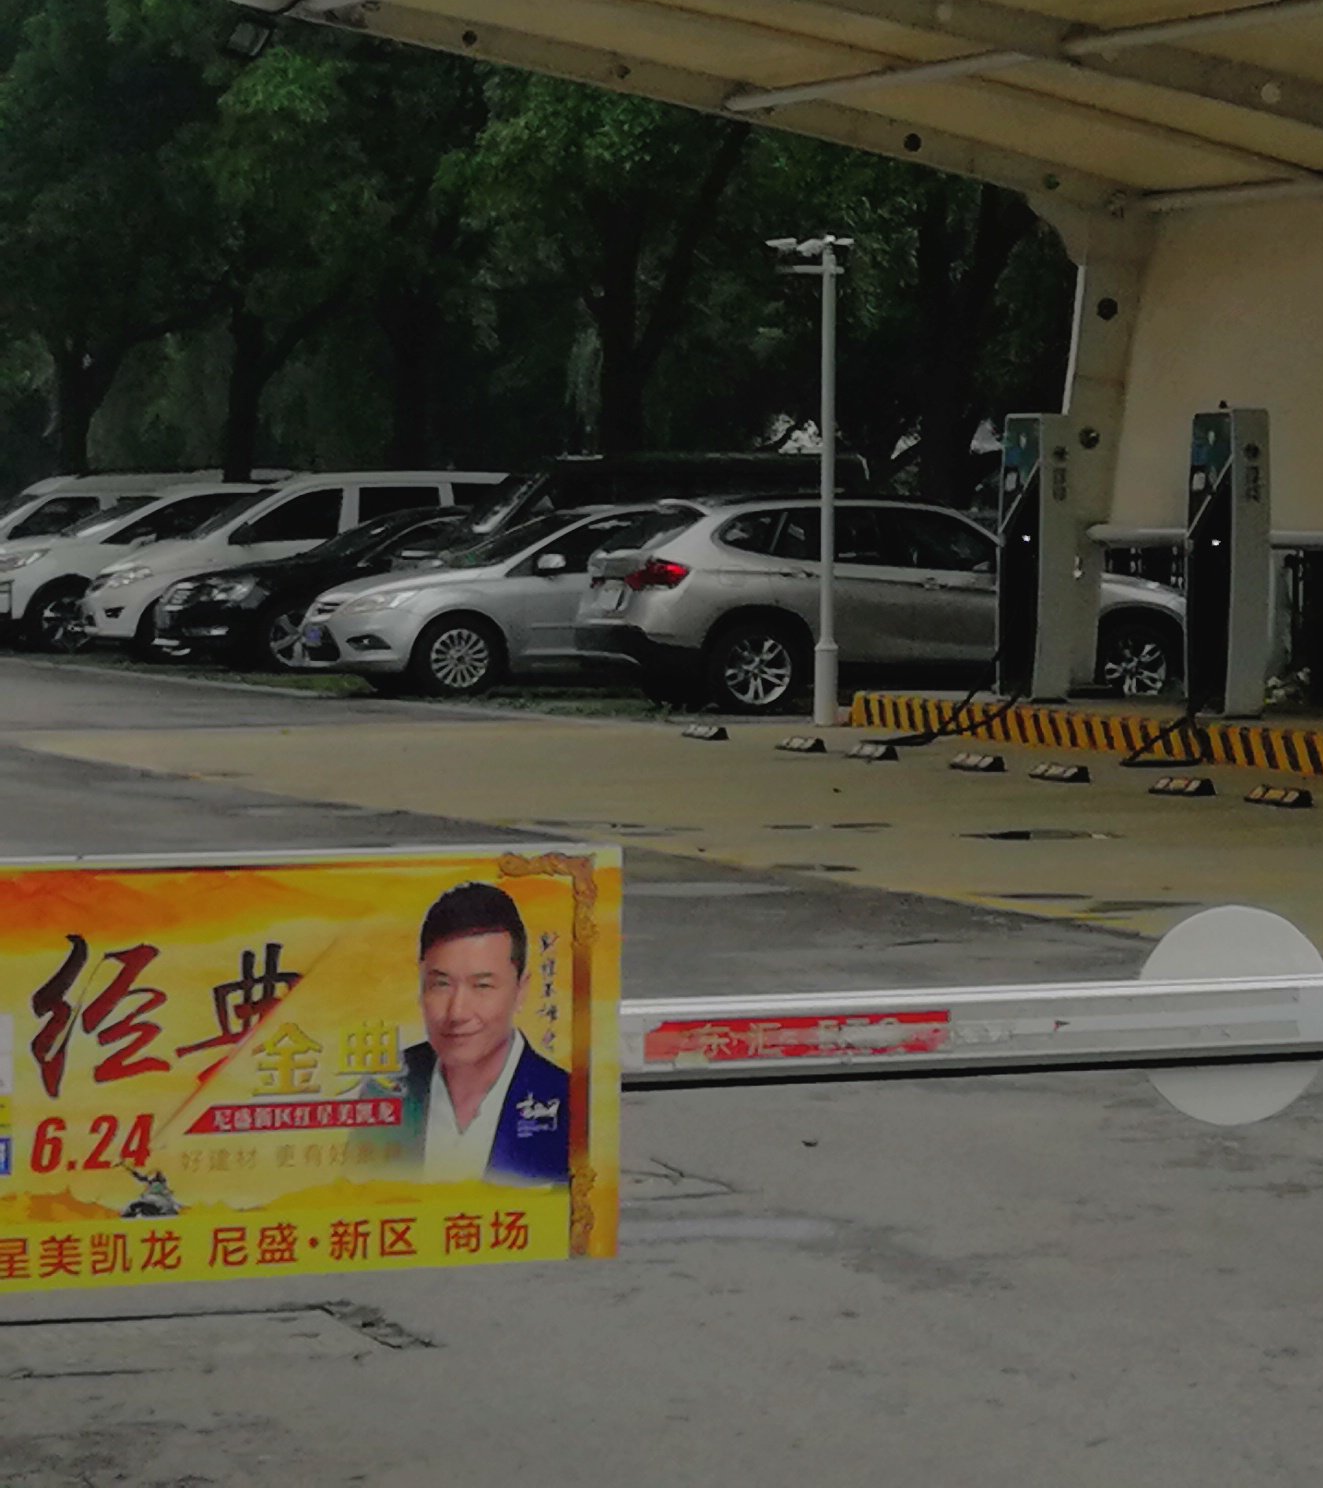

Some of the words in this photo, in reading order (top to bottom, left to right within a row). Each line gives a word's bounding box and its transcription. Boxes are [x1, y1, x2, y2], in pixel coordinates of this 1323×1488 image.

[31, 934, 304, 1099] 经典
[252, 1019, 403, 1097] 金典
[30, 1113, 154, 1174] 6.24
[444, 1210, 529, 1255] 商场
